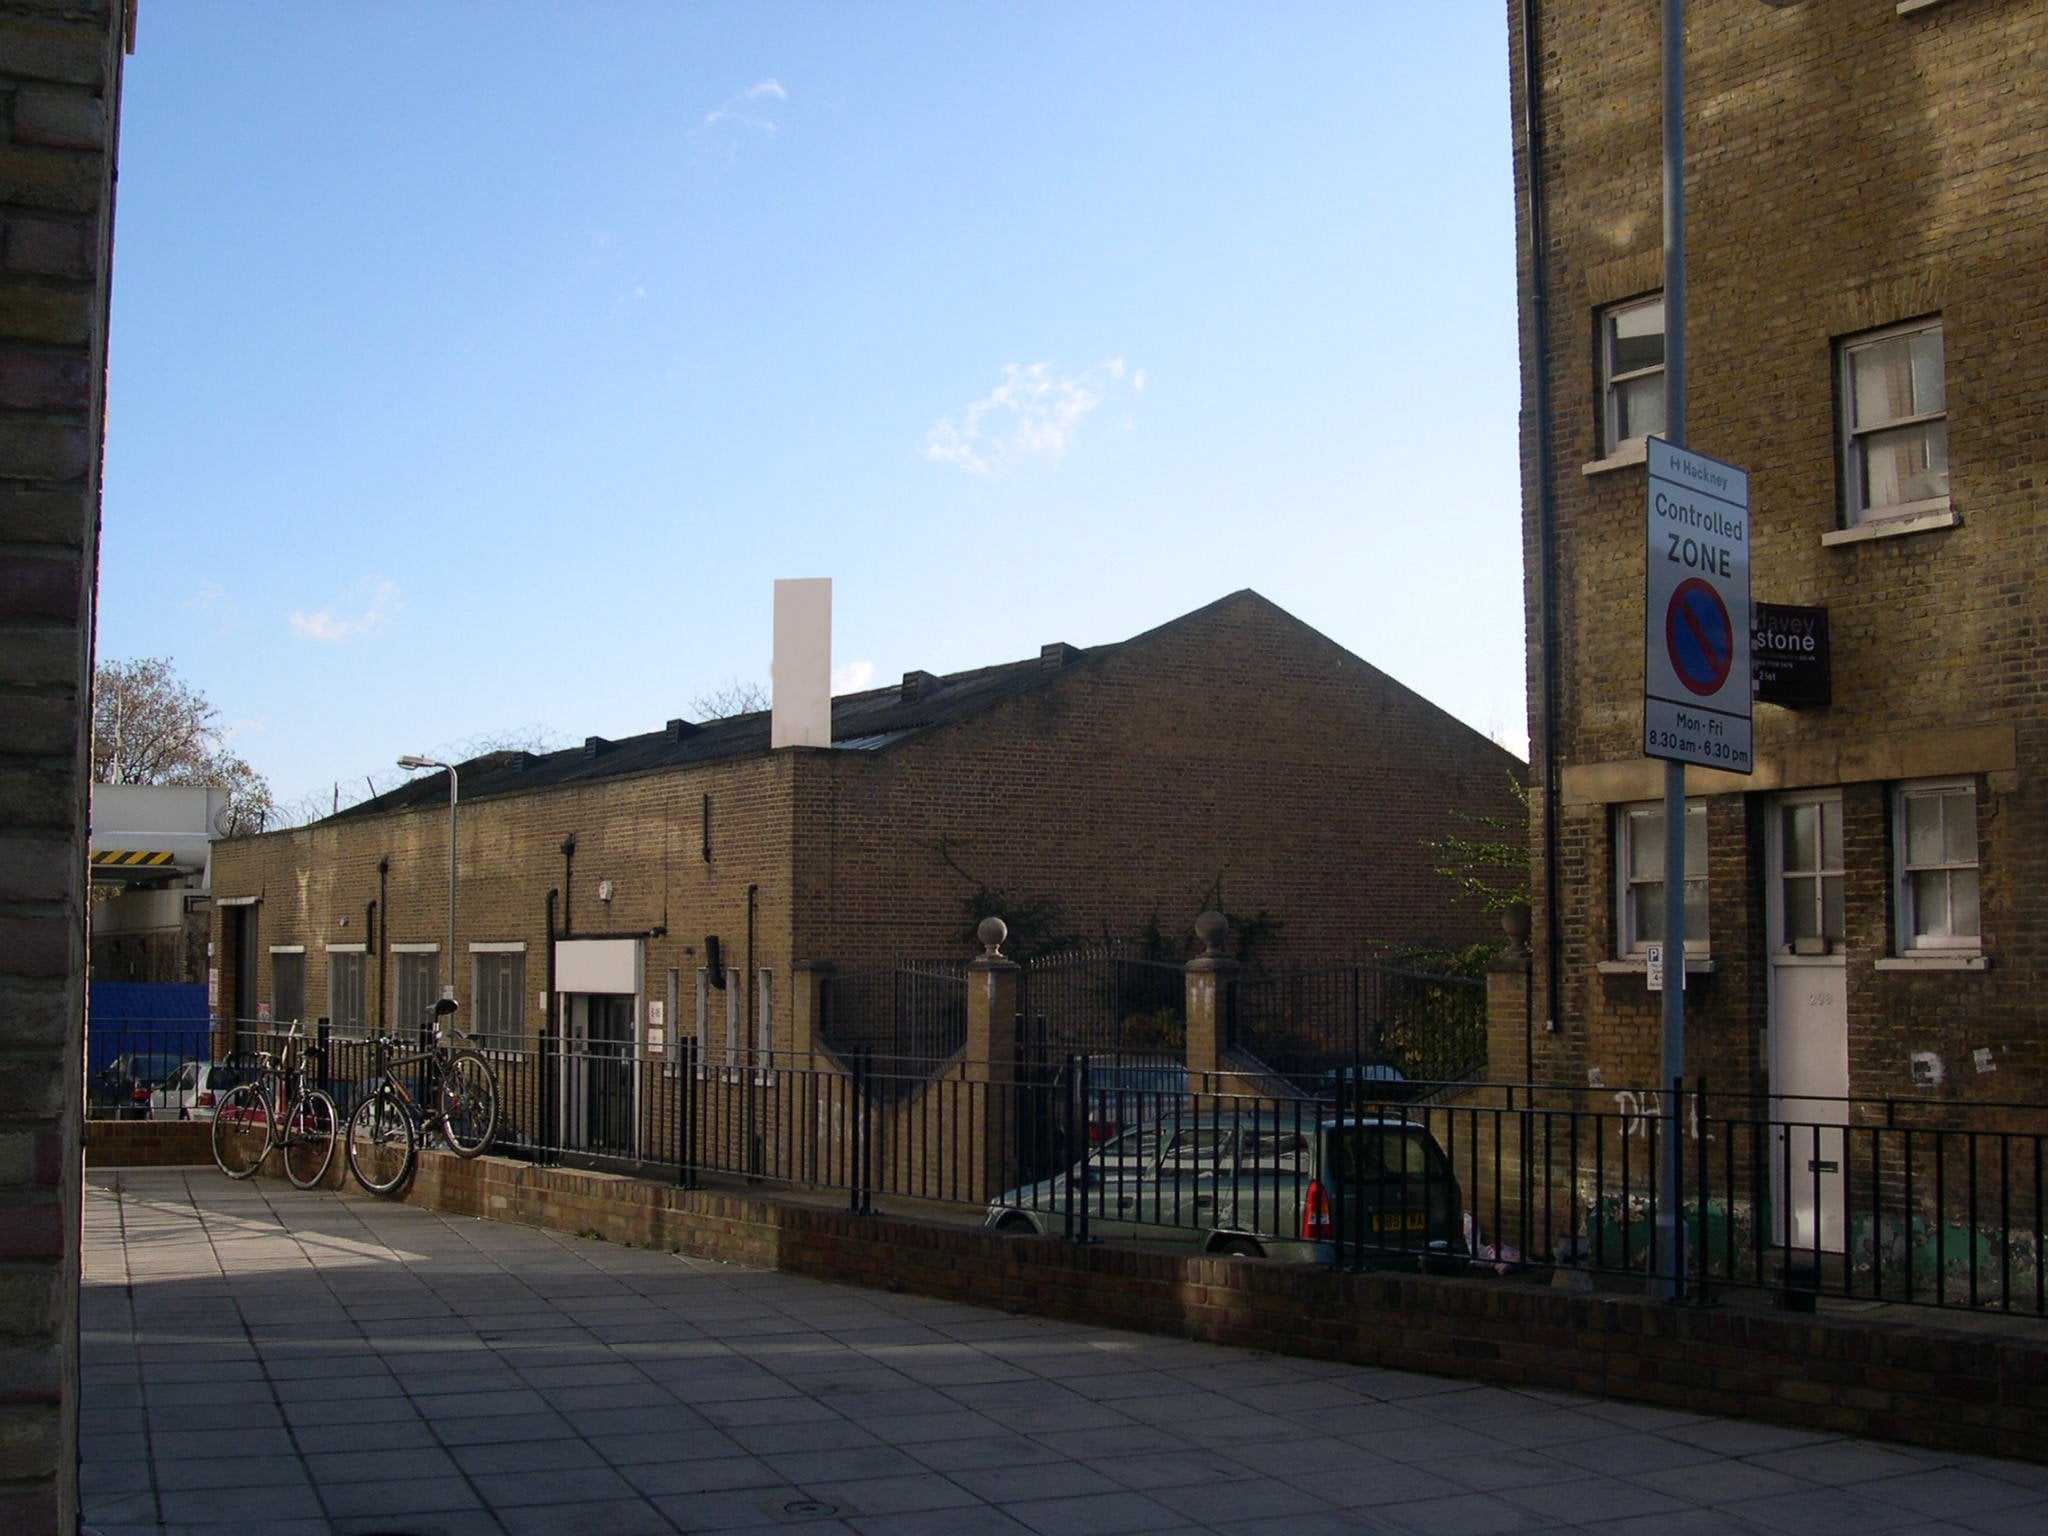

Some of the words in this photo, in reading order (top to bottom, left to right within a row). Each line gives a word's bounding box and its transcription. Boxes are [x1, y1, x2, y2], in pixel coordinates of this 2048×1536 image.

[1683, 459, 1728, 491] Hackney
[1655, 493, 1742, 541] Controlled
[1667, 532, 1731, 578] ZONE
[1757, 630, 1815, 651] stone
[1676, 712, 1700, 731] Mon
[1709, 719, 1723, 736] Fri
[1732, 750, 1748, 762] pm
